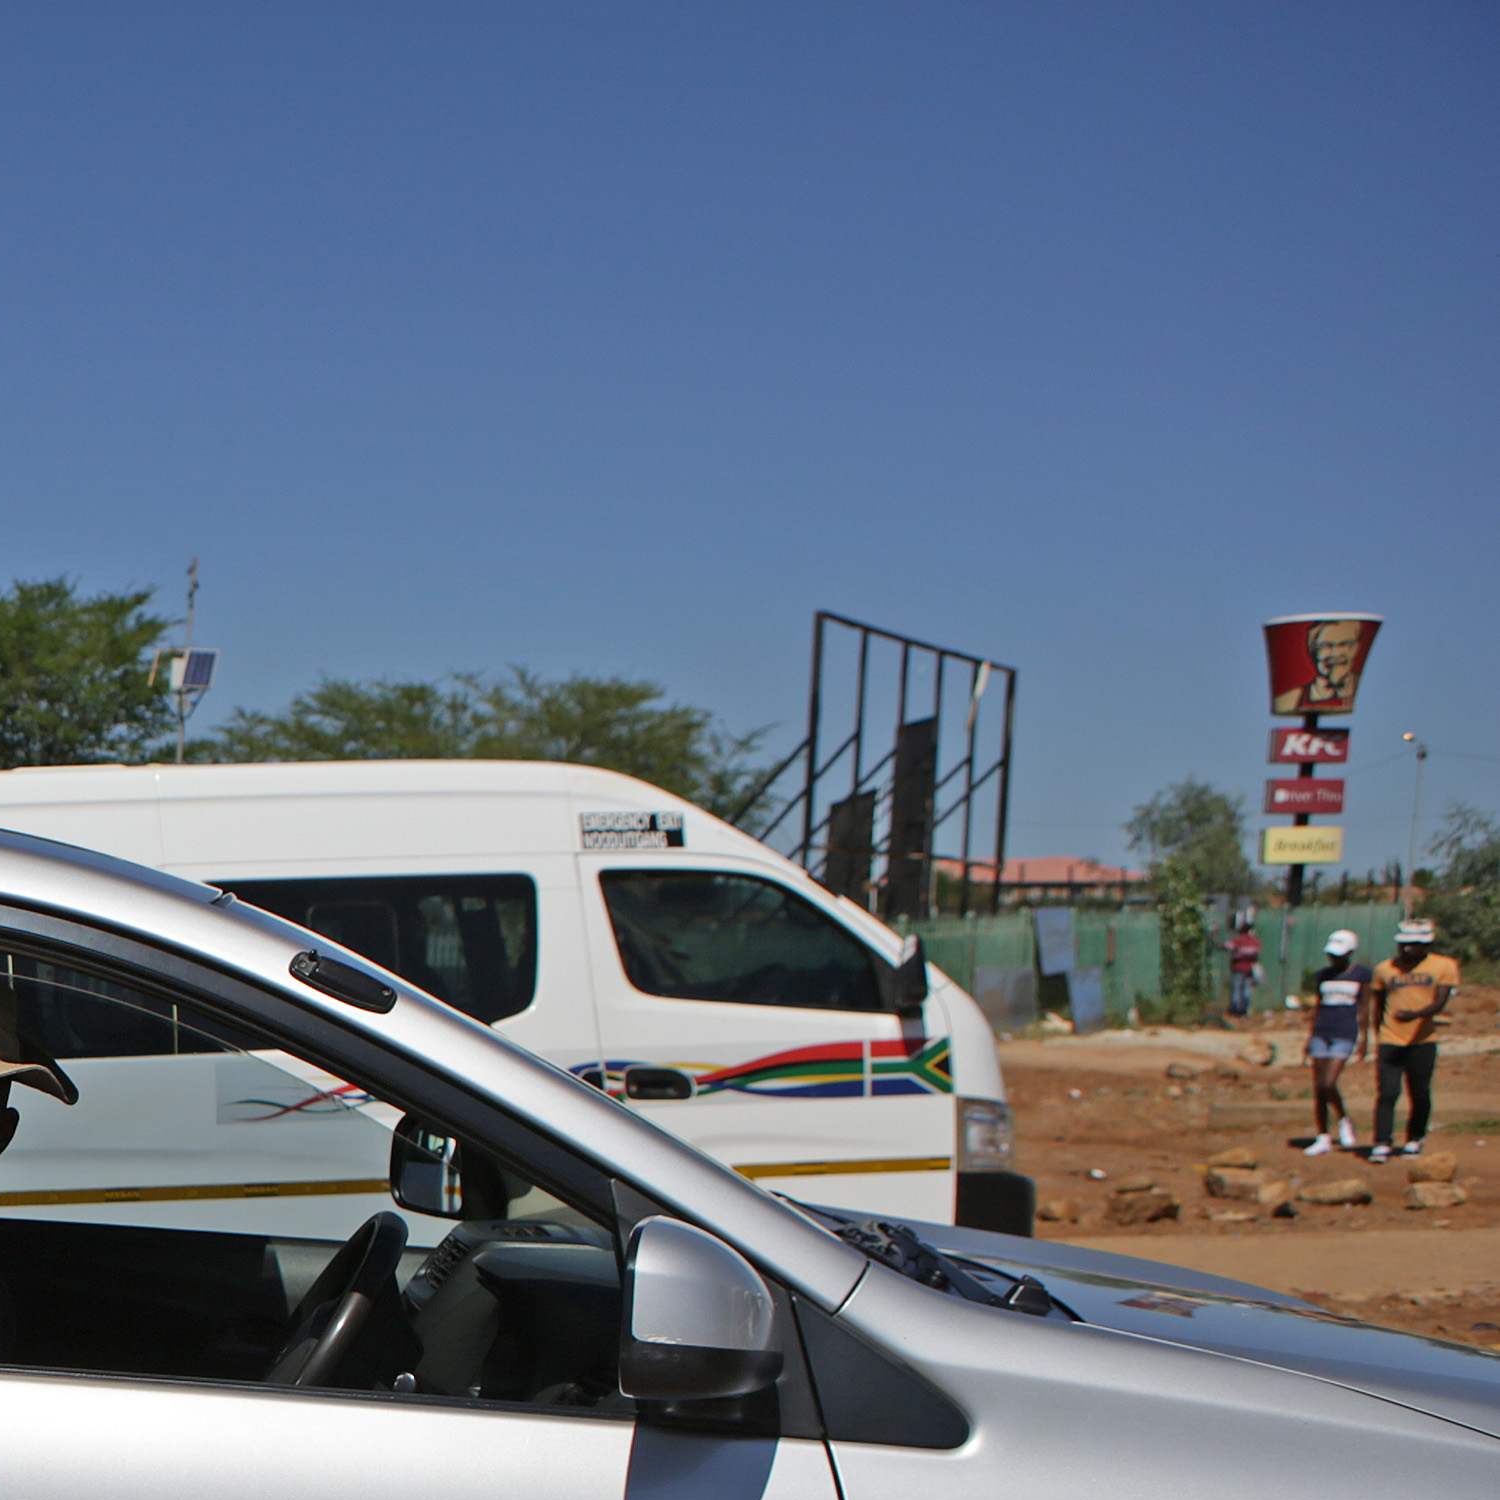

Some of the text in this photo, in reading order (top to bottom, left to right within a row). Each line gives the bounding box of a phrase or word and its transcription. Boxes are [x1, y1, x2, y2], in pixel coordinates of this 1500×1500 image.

[1281, 734, 1343, 756] KFC
[583, 811, 684, 831] EMERGENCY EXIT
